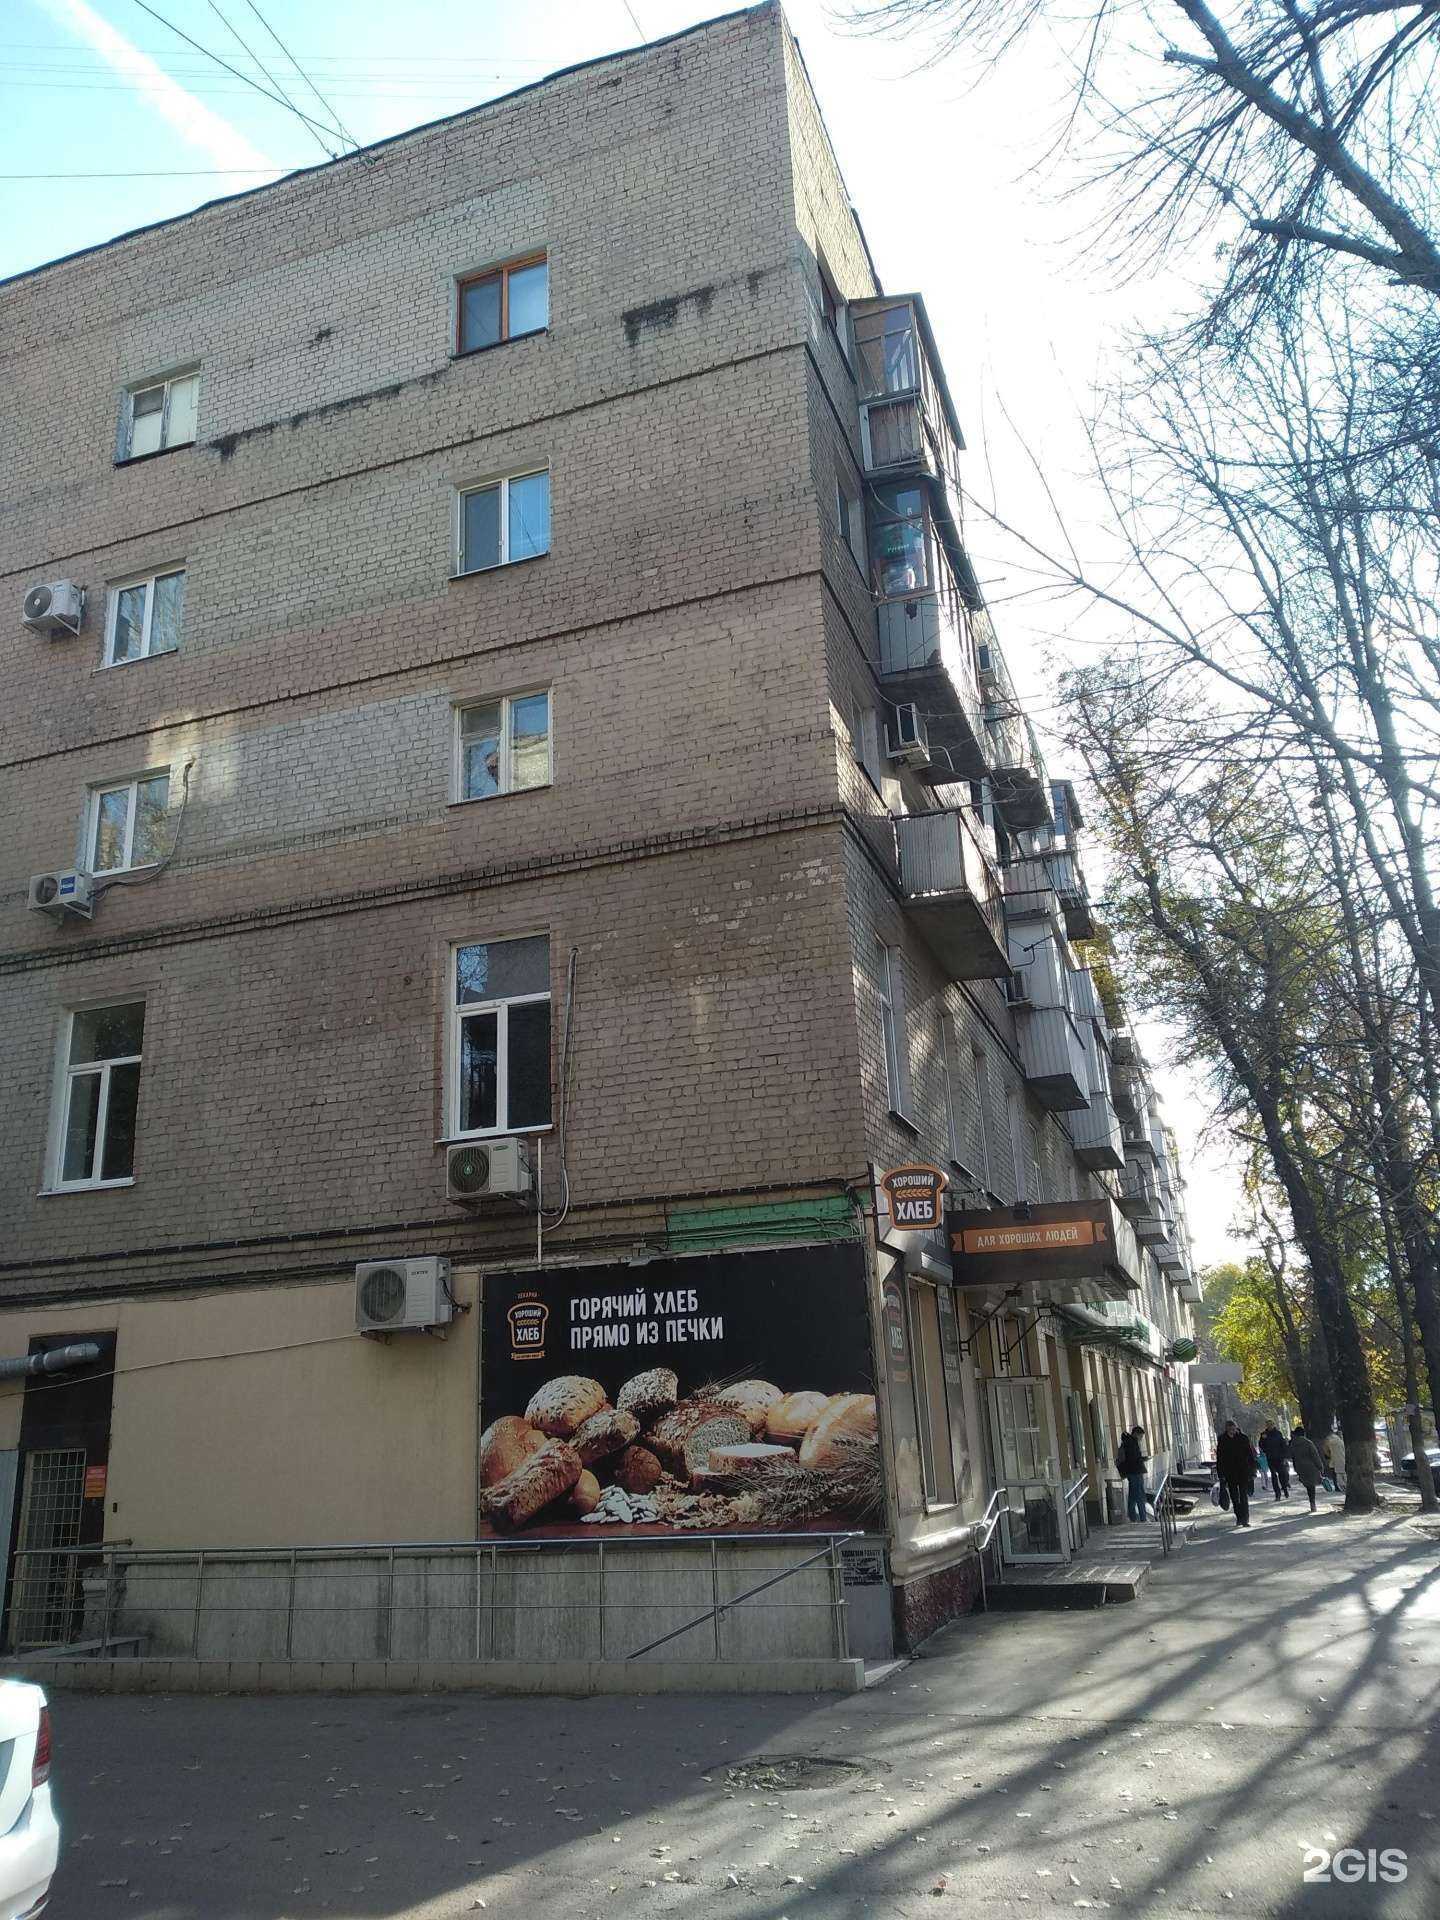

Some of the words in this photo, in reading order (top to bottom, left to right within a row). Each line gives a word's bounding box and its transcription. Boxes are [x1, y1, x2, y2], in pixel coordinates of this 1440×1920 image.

[892, 1174, 934, 1188] ХОРОШИЙ
[896, 1201, 933, 1220] ХЛЕБ
[977, 1236, 996, 1248] ДЛЯ
[999, 1231, 1042, 1246] ХОРОШИХ
[1045, 1226, 1079, 1242] ЛЮДЕЙ
[515, 1308, 542, 1319] ХОРОШИЙ
[570, 1288, 647, 1321] ГОРЯЧИЙ
[653, 1289, 699, 1315] ХЛЕБ
[516, 1327, 540, 1342] ХЛЕБ
[570, 1323, 630, 1350] ПРЯМО
[636, 1321, 659, 1345] ИЗ
[665, 1316, 724, 1343] ПЕЧКИ
